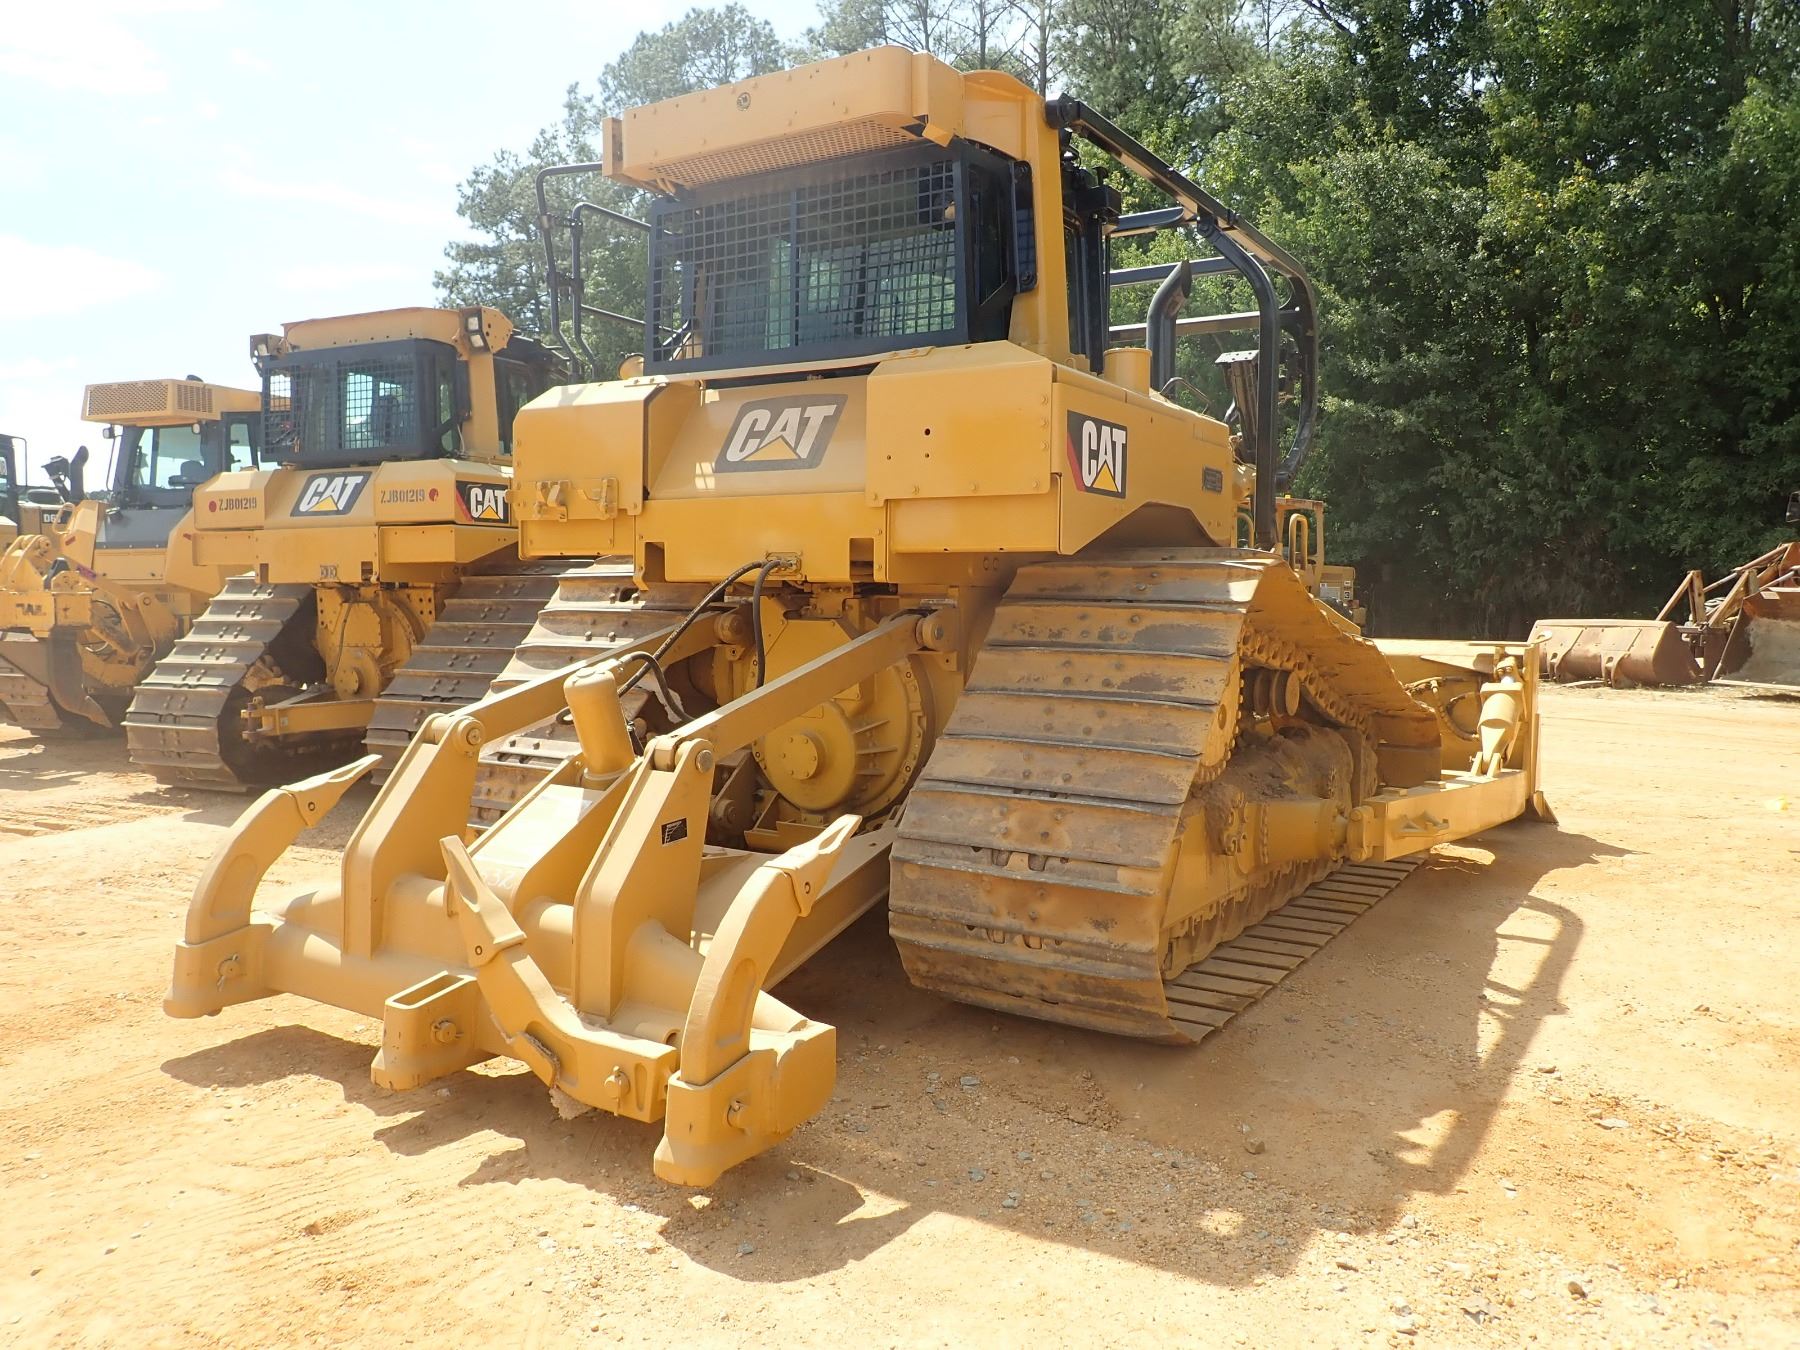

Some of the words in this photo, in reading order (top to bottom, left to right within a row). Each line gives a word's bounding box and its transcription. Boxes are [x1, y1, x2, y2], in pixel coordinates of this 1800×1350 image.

[726, 405, 837, 461] CAT
[1082, 420, 1126, 493] CAT
[300, 476, 363, 511] CAT
[471, 487, 505, 519] CAT
